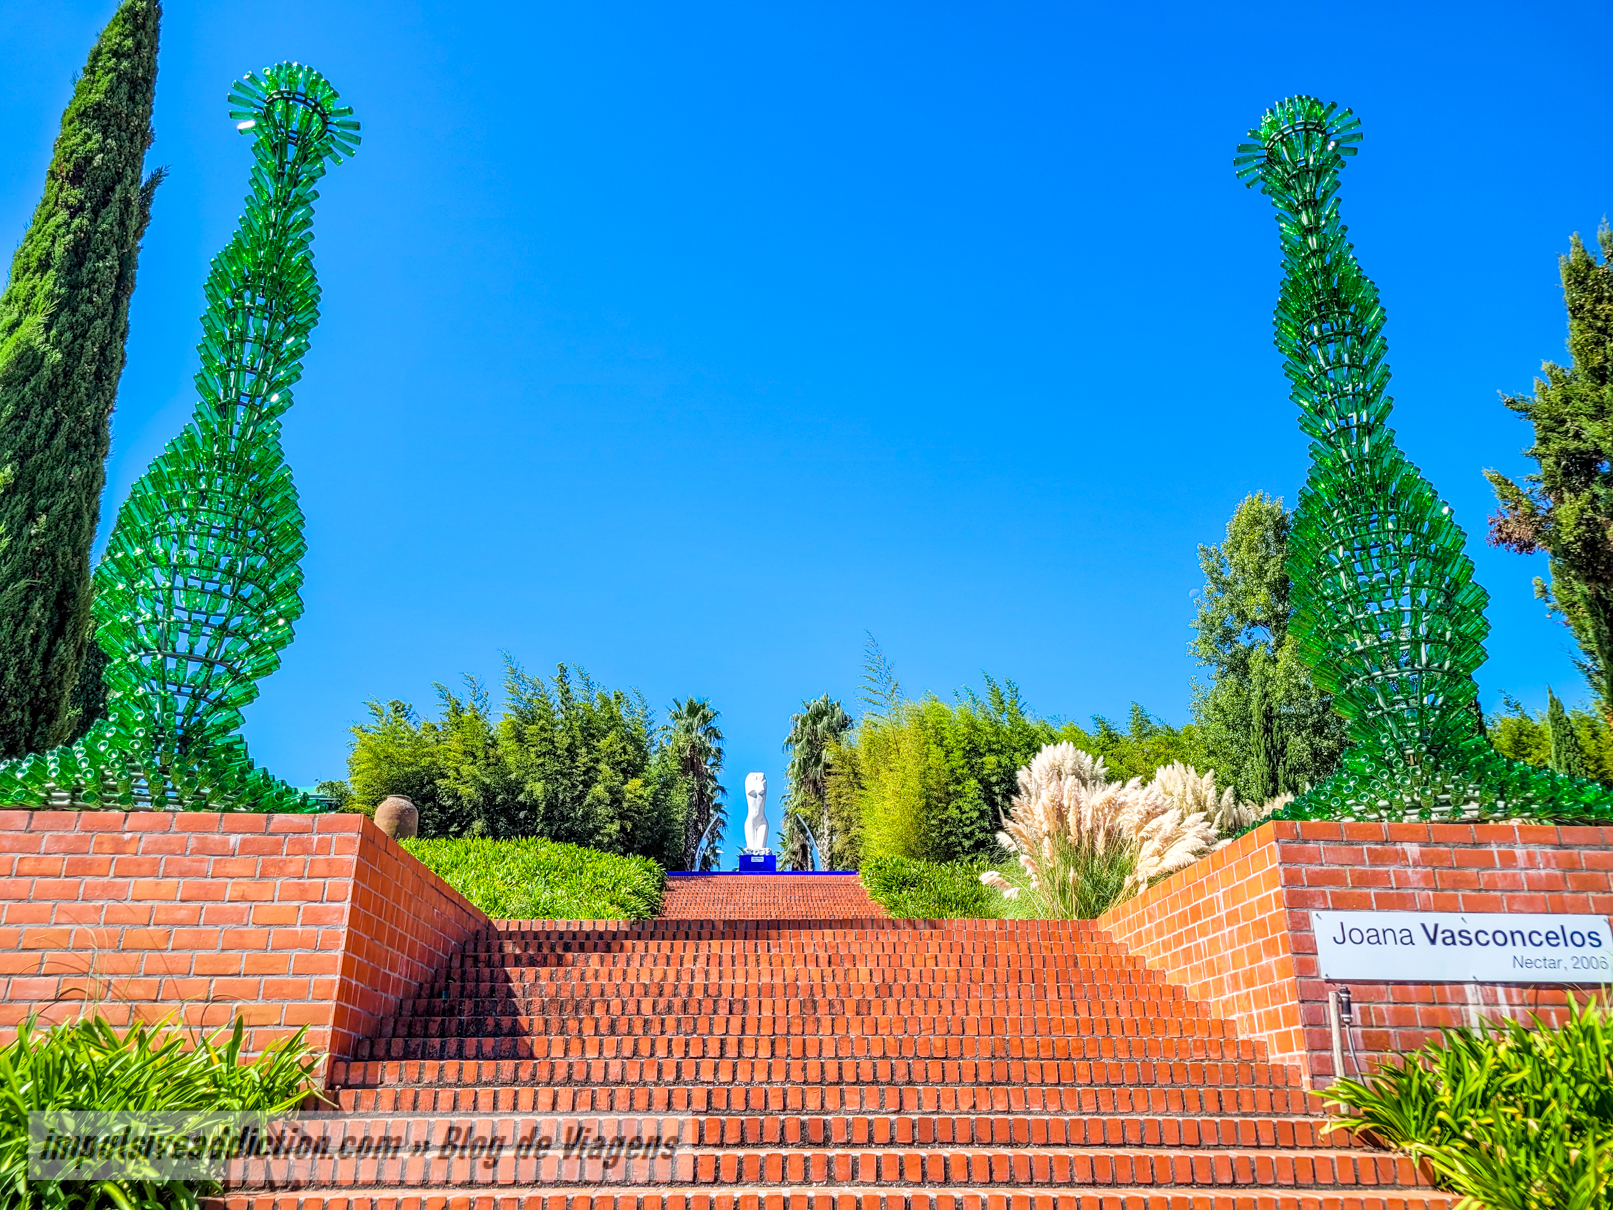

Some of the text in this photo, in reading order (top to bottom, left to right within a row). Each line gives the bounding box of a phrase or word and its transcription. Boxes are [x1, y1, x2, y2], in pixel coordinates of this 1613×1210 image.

[1332, 921, 1603, 948] Joana Vasconcelos
[1512, 955, 1610, 971] Nectar, 2006
